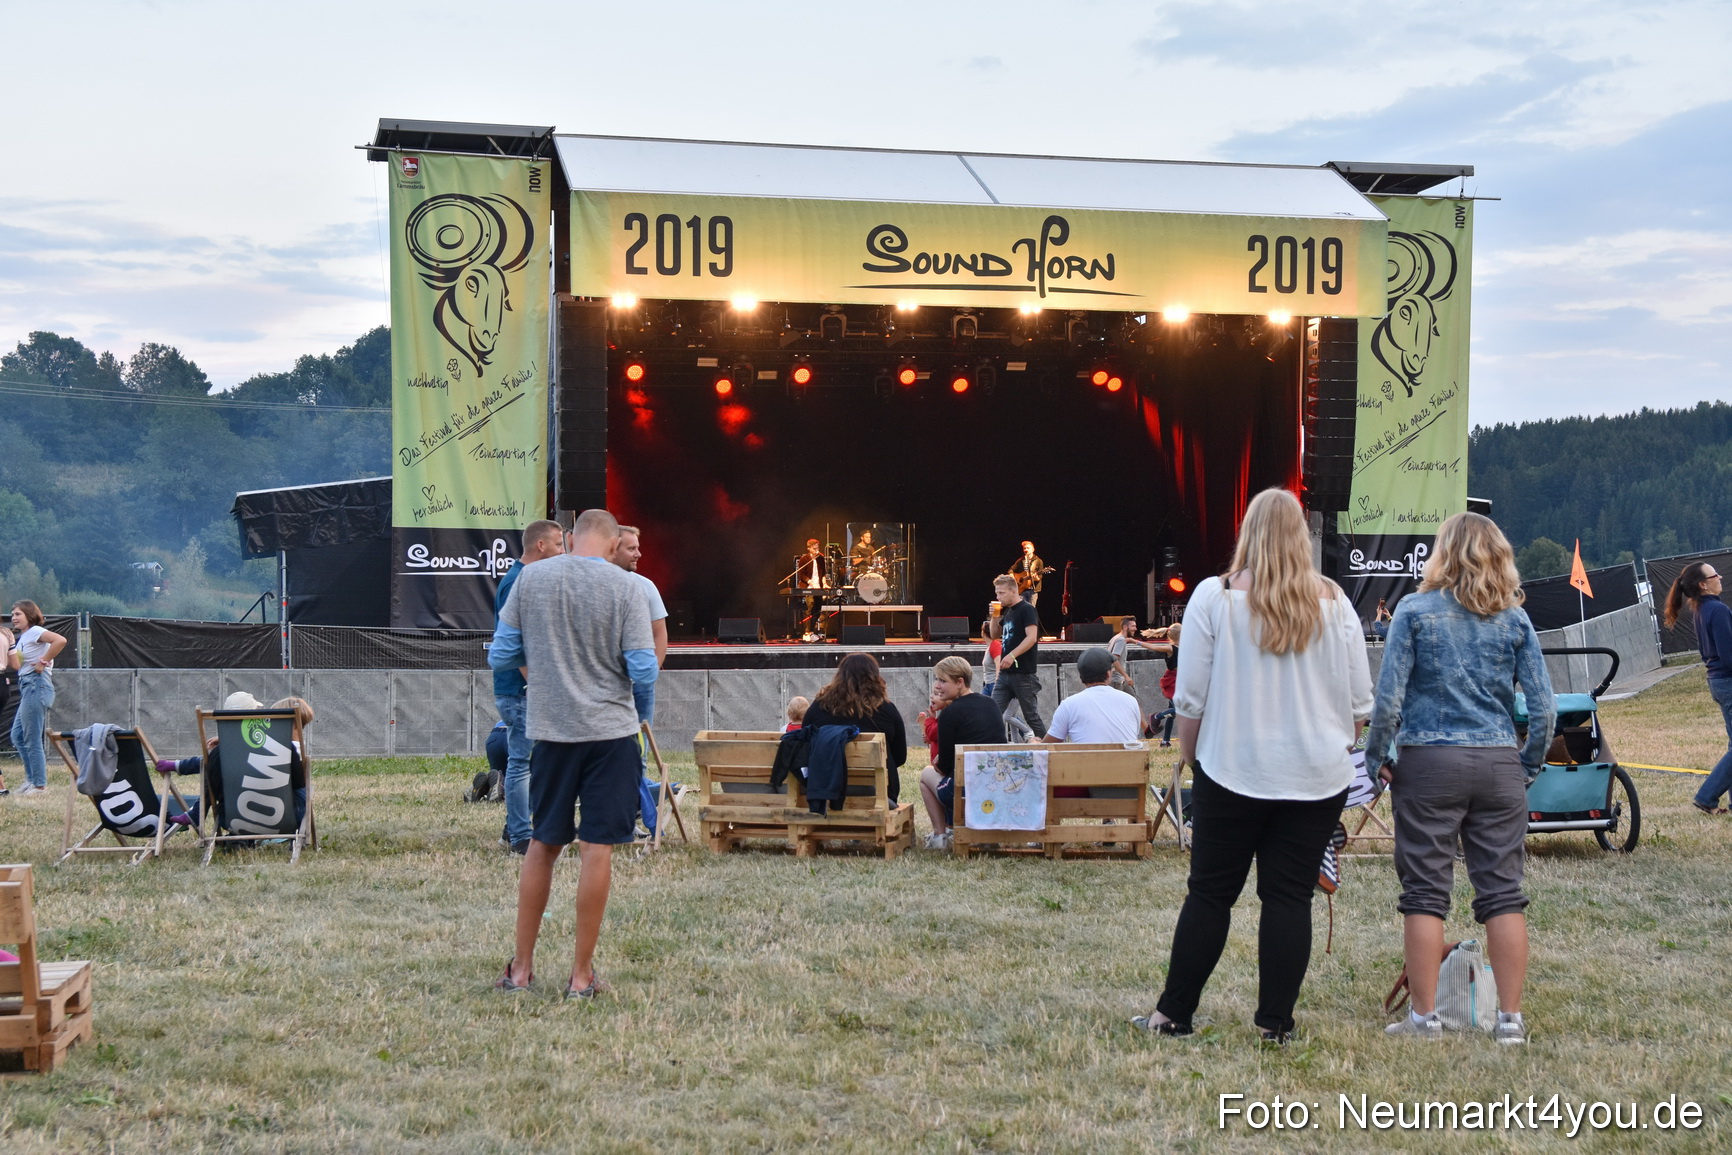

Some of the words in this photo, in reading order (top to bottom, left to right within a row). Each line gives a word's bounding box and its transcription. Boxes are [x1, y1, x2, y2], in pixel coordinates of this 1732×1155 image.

[529, 167, 541, 193] now
[1455, 205, 1466, 229] now
[623, 212, 734, 278] 2019
[1247, 234, 1343, 296] 2019
[399, 447, 422, 467] Das
[478, 538, 516, 579] HOR
